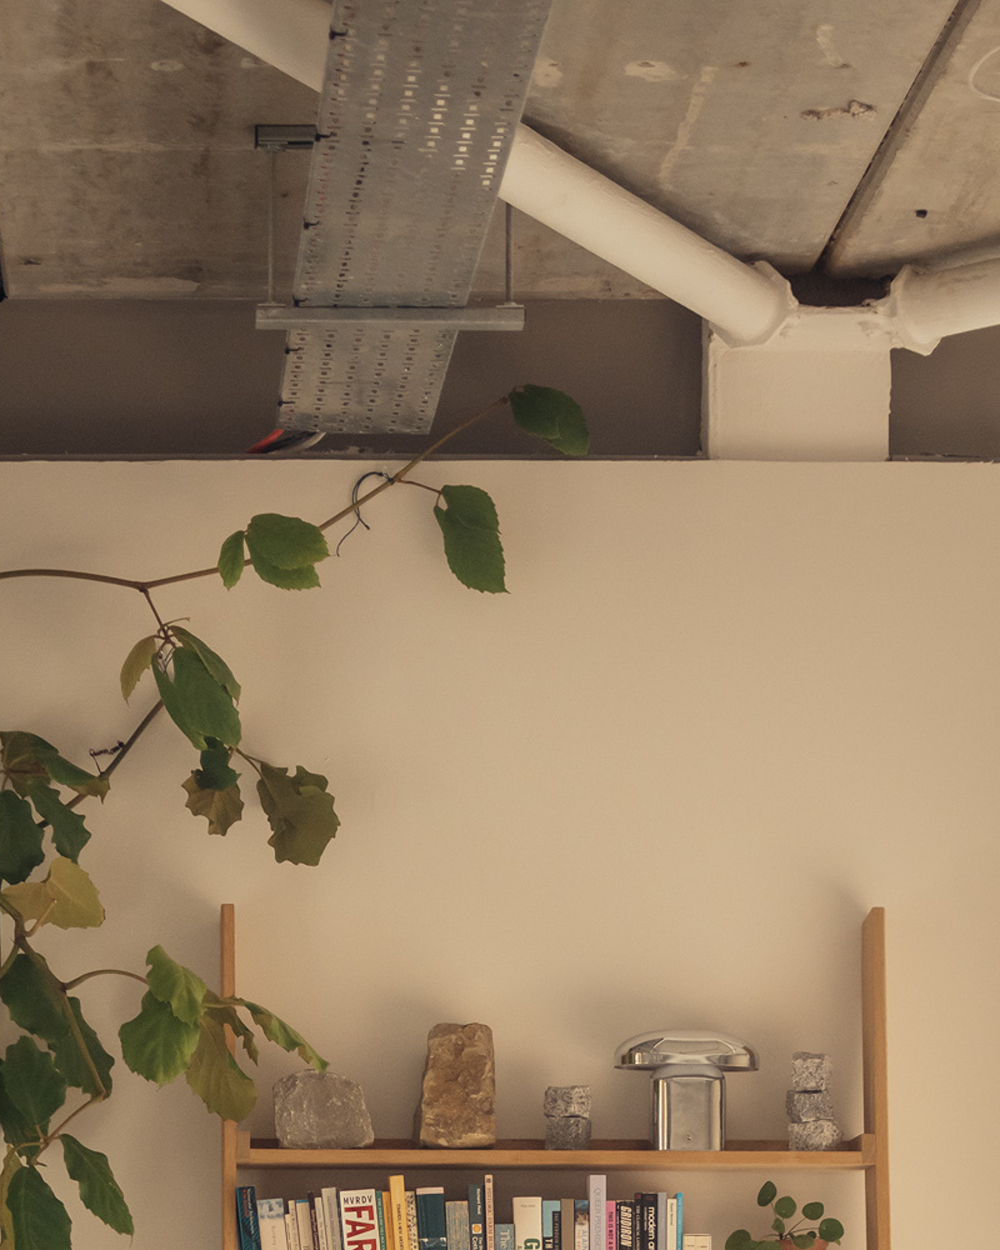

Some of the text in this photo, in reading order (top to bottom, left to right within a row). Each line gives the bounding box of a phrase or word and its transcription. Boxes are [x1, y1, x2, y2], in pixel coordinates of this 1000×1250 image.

[343, 1195, 373, 1204] MVRDV
[593, 1187, 601, 1214] QUEER
[620, 1205, 632, 1246] GRIDIRON
[647, 1206, 656, 1240] modern
[499, 1228, 510, 1249] The
